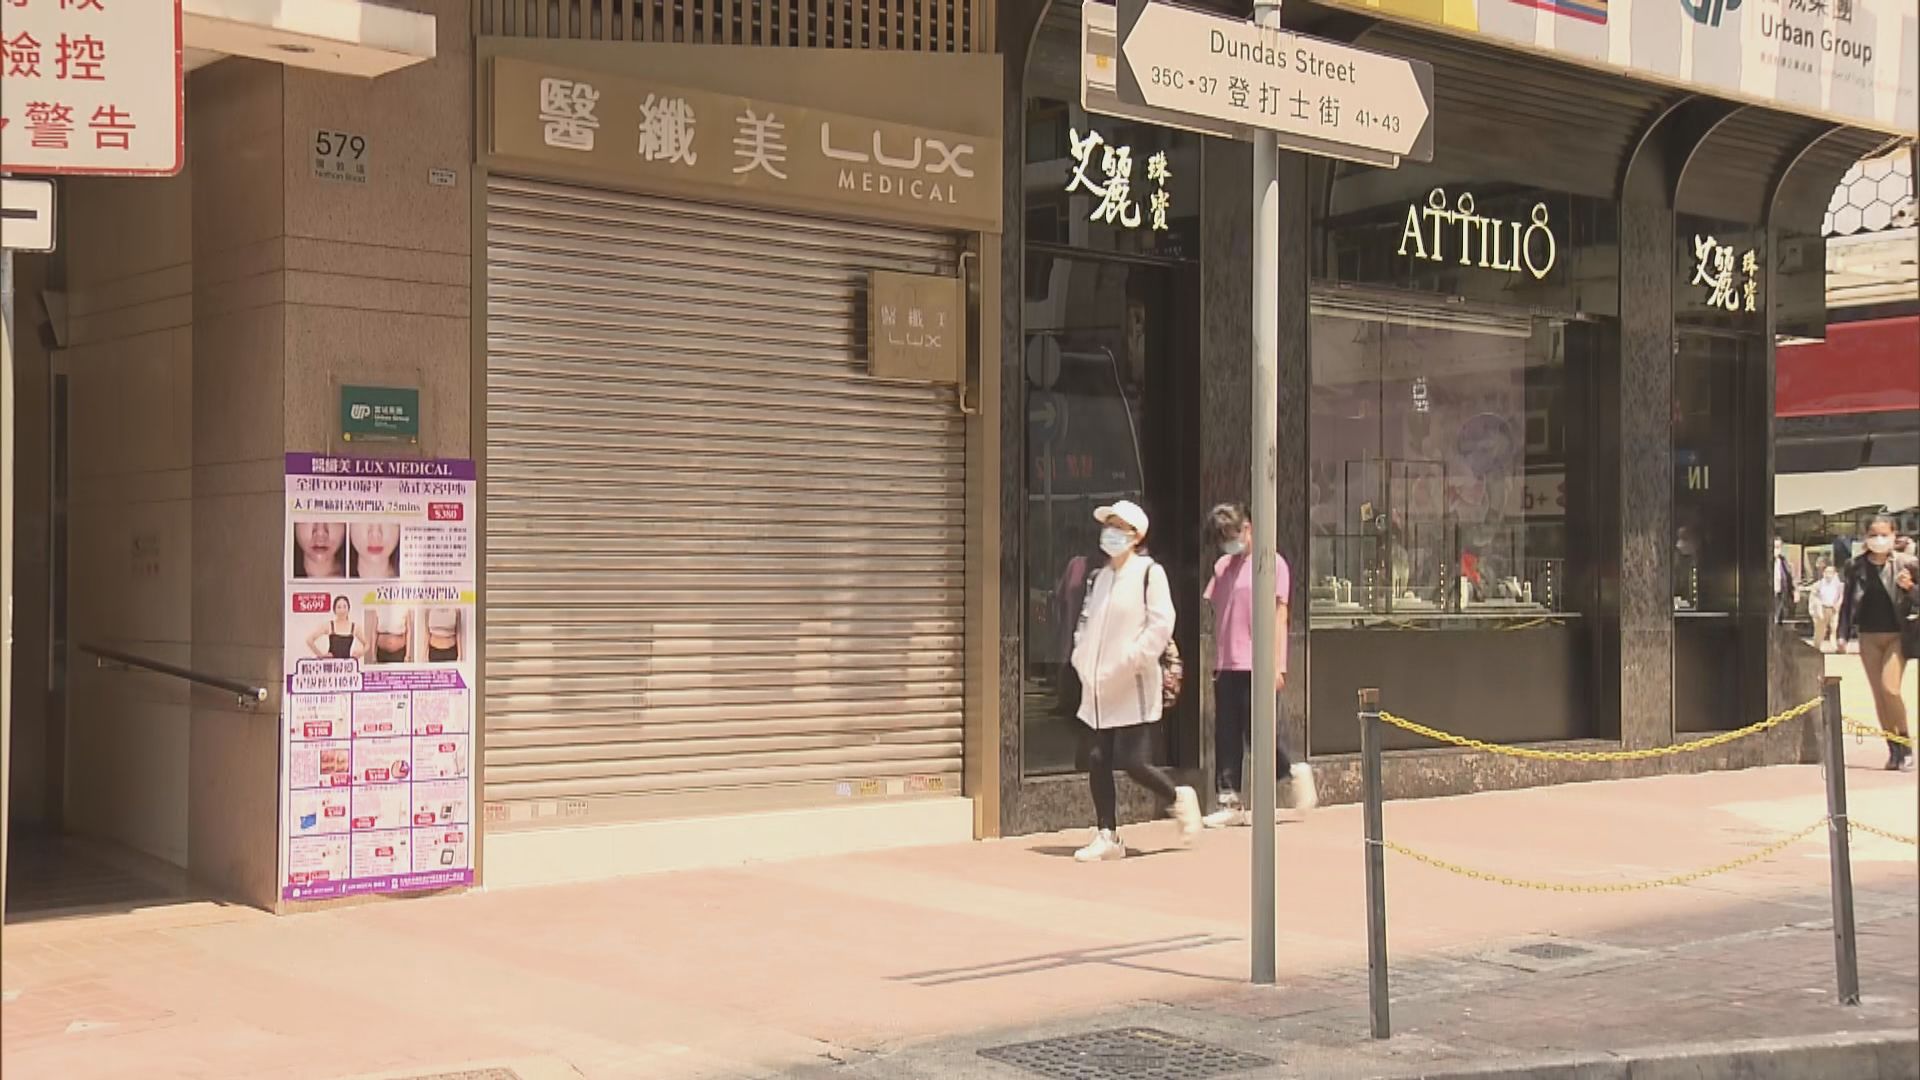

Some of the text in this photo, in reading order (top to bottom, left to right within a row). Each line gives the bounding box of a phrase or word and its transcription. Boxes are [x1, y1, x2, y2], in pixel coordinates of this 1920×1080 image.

[1210, 29, 1357, 84] Dundas Street
[1760, 12, 1814, 49] Urban
[1820, 29, 1873, 67] Group
[1, 101, 137, 151] 警告
[1227, 75, 1340, 128] 登打士街
[315, 130, 366, 160] 579
[538, 77, 788, 180] 醫纖美
[821, 121, 975, 178] LUX
[838, 168, 958, 205] MEDICAL
[1398, 187, 1556, 280] ATTILIO
[888, 331, 942, 348] LUX
[355, 460, 385, 474] LUX
[387, 461, 453, 476] MEDICAL
